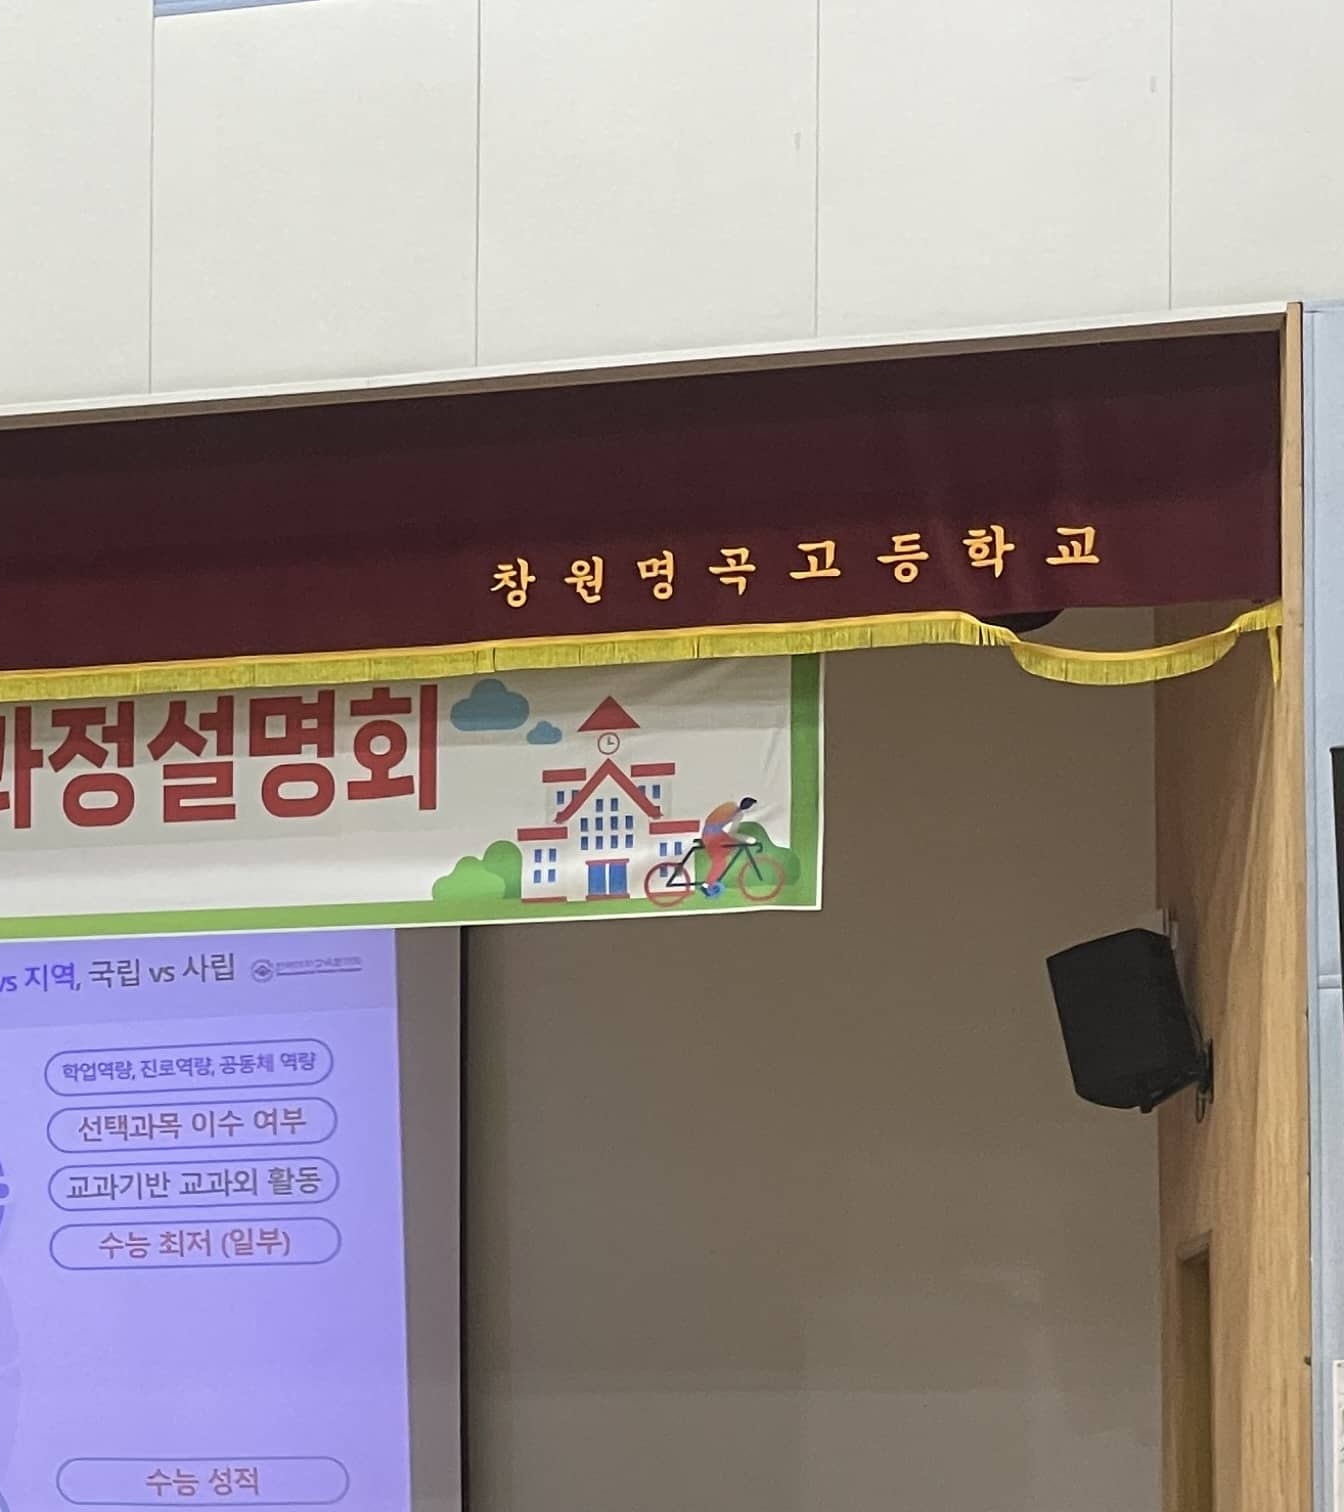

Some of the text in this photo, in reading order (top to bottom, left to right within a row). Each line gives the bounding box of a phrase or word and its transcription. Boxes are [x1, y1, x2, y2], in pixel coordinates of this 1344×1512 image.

[490, 524, 1101, 608] 창원명곡고등학교
[24, 962, 82, 992] 지역,
[87, 958, 142, 988] 국립
[148, 964, 176, 983] vs
[182, 952, 236, 983] 사립
[61, 1050, 317, 1082] 학업역량, 진로역량, 공동체 역량
[77, 1106, 307, 1143] 선택과목 이수 여부
[66, 1164, 322, 1201] 교과기반 교과외 활동
[97, 1226, 291, 1260] 수능 최저 (일부)
[145, 1466, 261, 1497] 수능 성적
